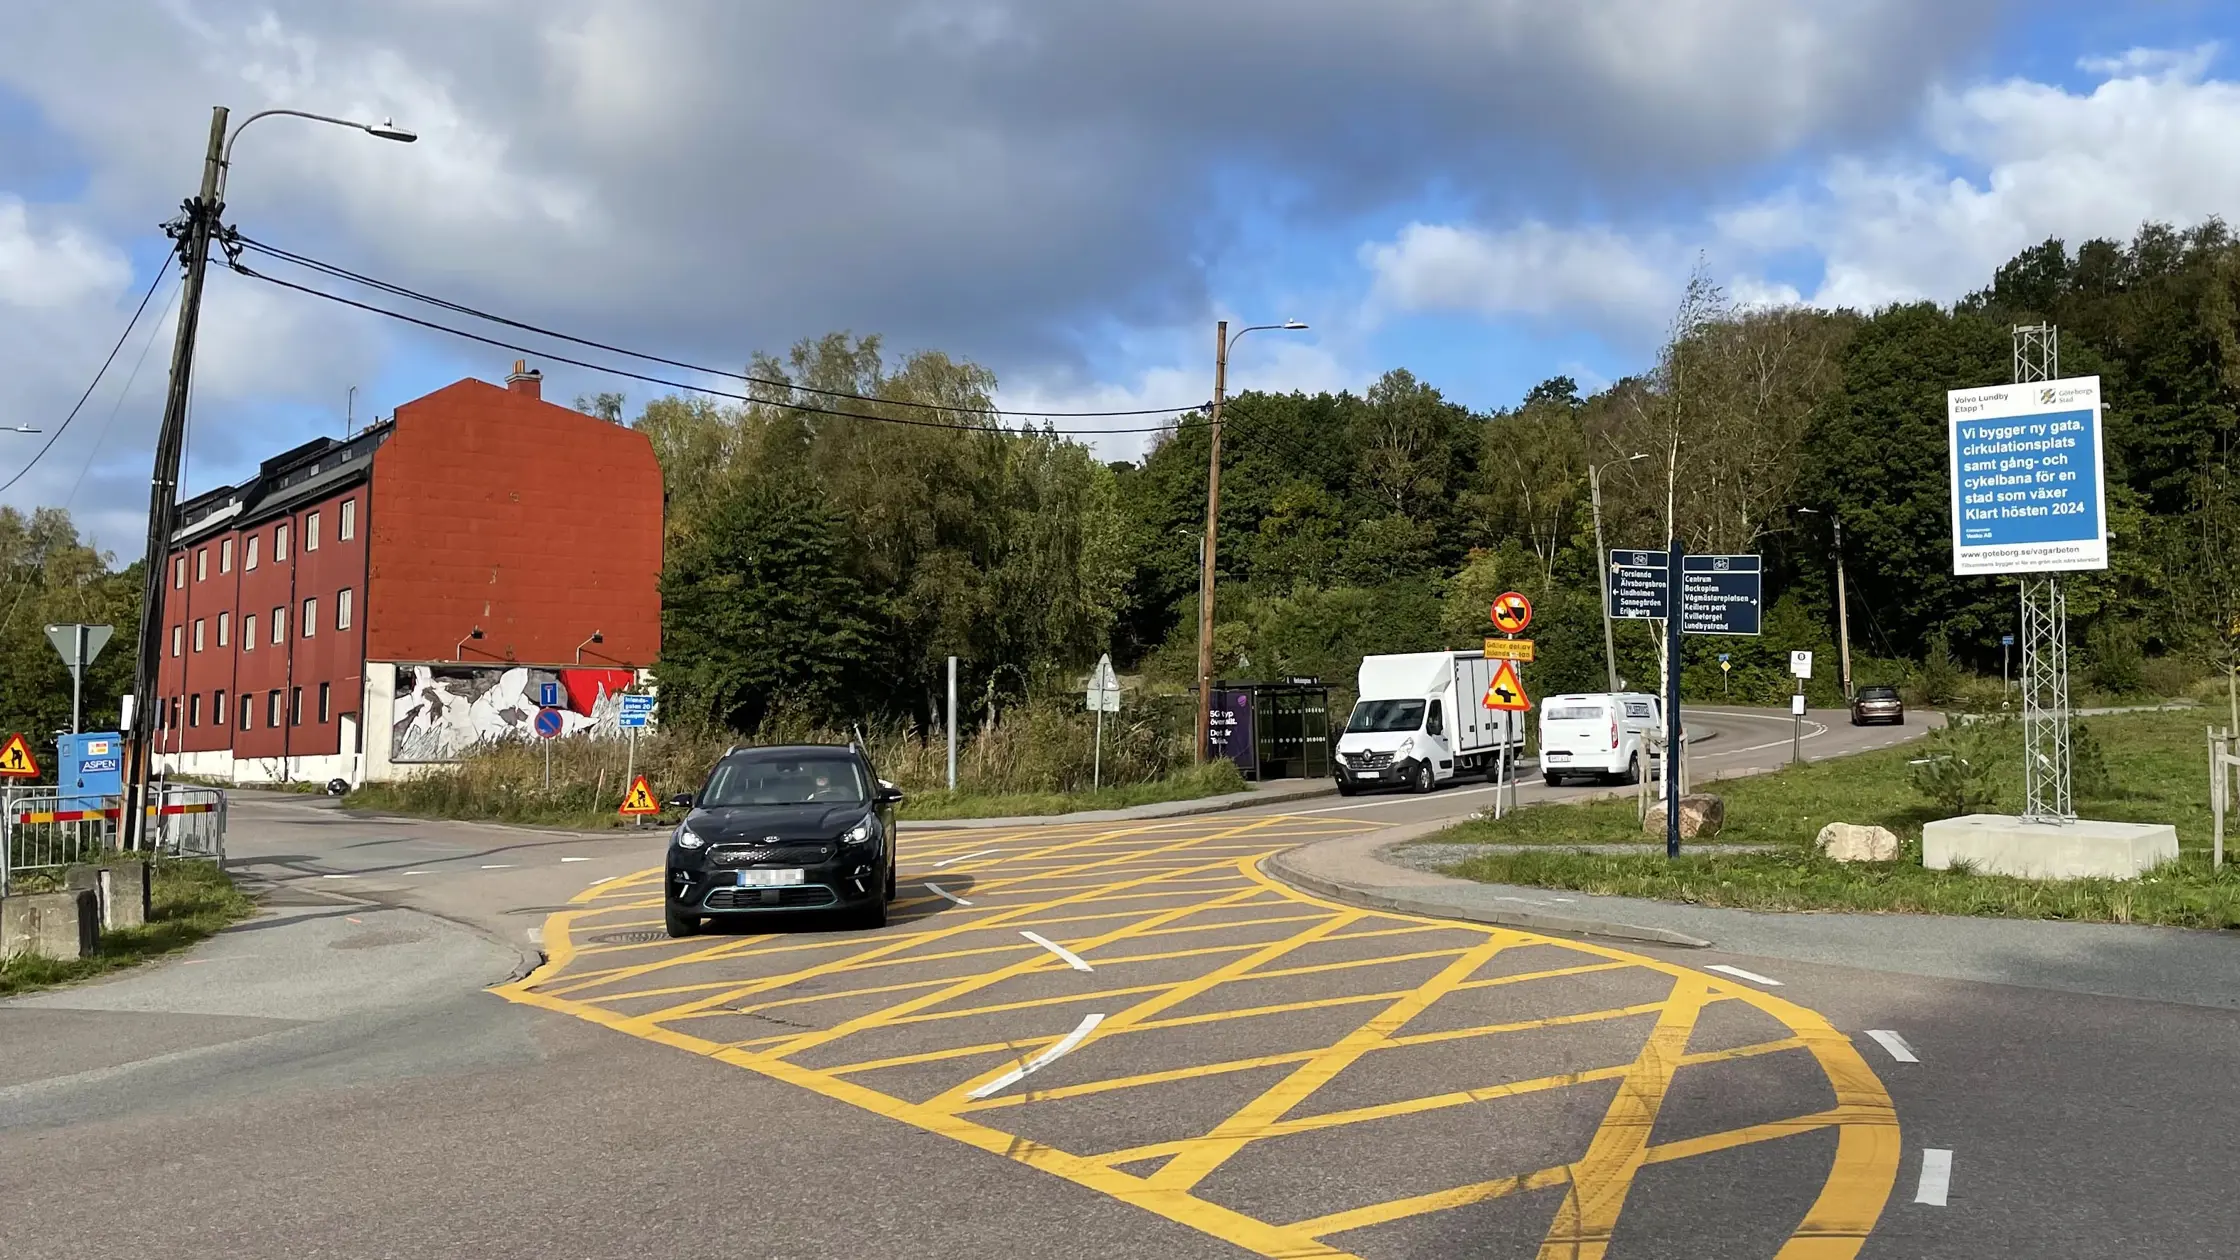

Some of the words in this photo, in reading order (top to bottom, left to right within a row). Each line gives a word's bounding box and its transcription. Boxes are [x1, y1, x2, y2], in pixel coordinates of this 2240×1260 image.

[1955, 396, 1976, 404] Volvo
[1978, 393, 2009, 402] Lundby
[1955, 405, 1978, 413] Etapp
[1962, 428, 1976, 440] Vi
[1979, 426, 2026, 440] bygger
[2030, 423, 2047, 436] ny
[2050, 420, 2084, 435] gata,
[1963, 437, 2076, 456] cirkulationsplats
[1964, 459, 1997, 472] samt
[2000, 456, 2040, 472] gång-
[2042, 453, 2068, 465] och
[1964, 474, 2032, 490] cykelbana
[2036, 471, 2056, 483] för
[2059, 471, 2076, 480] en
[1965, 491, 1993, 504] stad
[1997, 491, 2026, 502] som
[2030, 488, 2068, 500] växer
[1966, 507, 1998, 520] Klart
[2002, 506, 2048, 518] hösten
[2052, 502, 2085, 515] 2024
[1961, 547, 2079, 558] www.goteborg.se/vagarbeten
[1621, 569, 1652, 578] Torslanda
[1685, 575, 1712, 583] Centrum
[1620, 577, 1667, 589] Älvsborgsbron
[1620, 588, 1655, 597] Lindholmen
[1685, 593, 1749, 603] Vågmästareplatsen
[1620, 597, 1662, 607] Sannegården
[1685, 603, 1710, 611] Keillers
[1711, 603, 1727, 612] park
[1685, 612, 1723, 622] Kvilletorget
[1684, 621, 1729, 631] Lundbystrand
[82, 759, 116, 772] ASPEN
